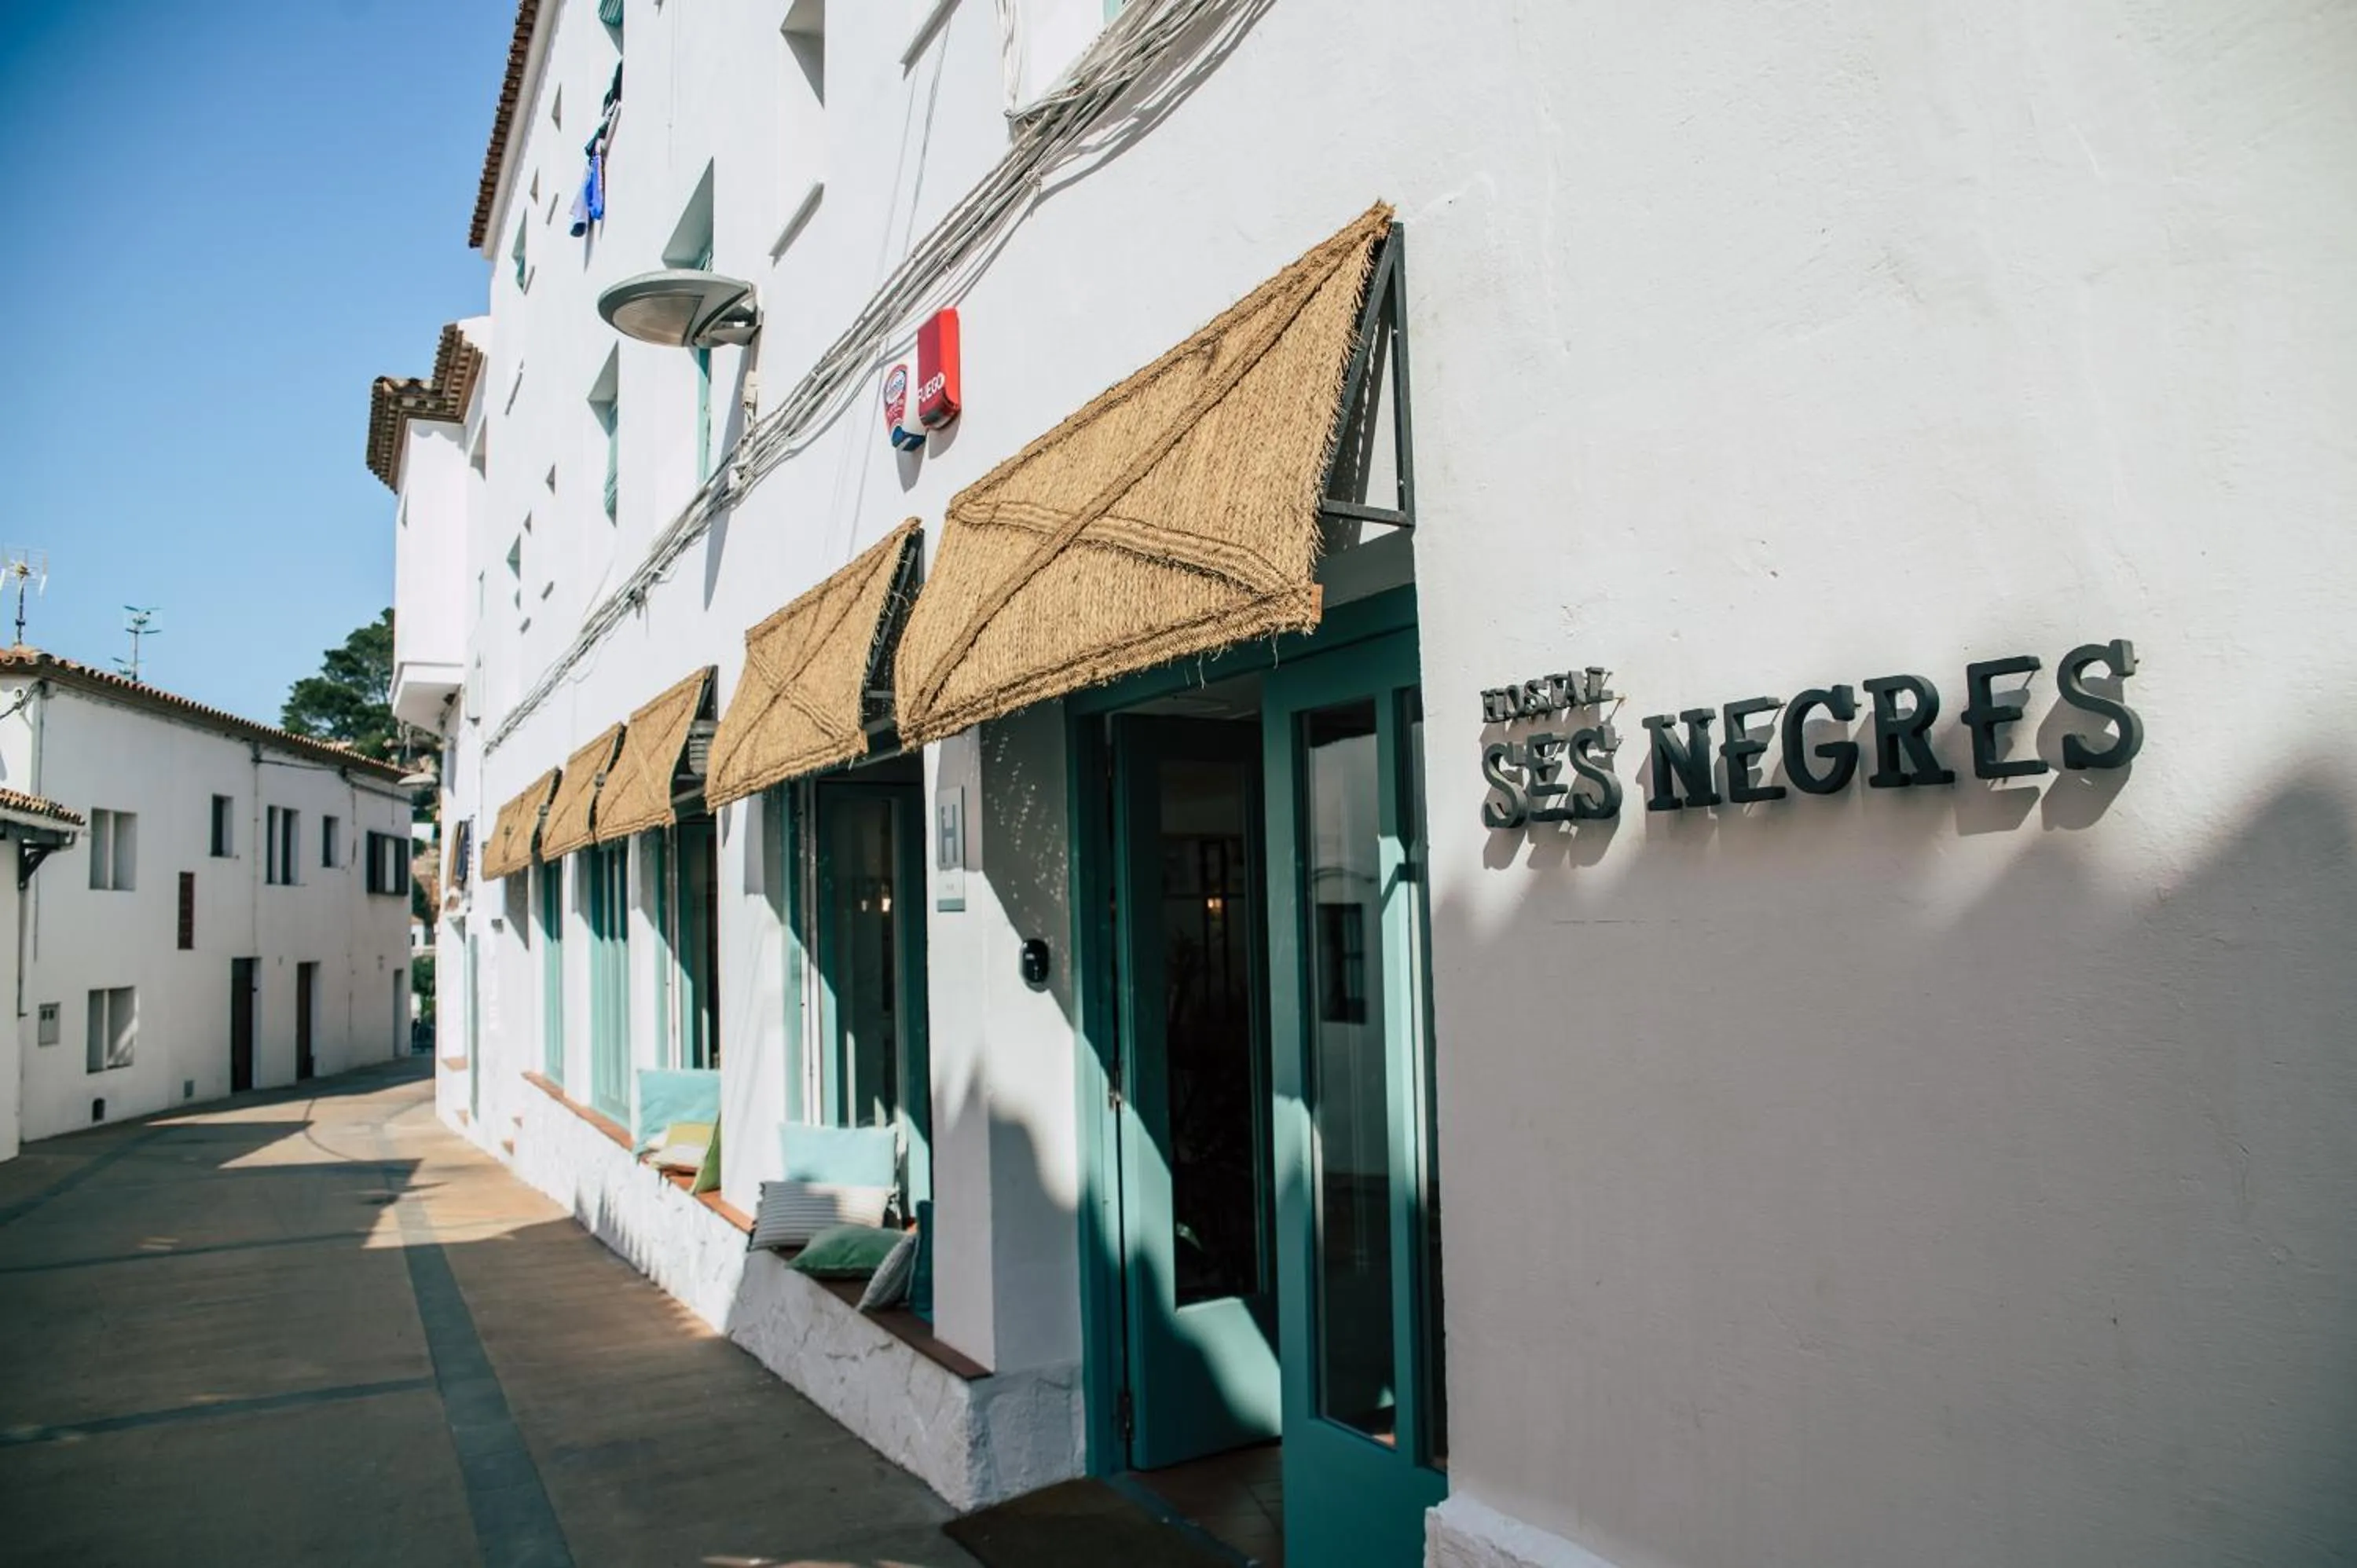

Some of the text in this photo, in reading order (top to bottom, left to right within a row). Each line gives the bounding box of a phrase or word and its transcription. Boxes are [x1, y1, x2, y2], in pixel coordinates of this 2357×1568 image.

[1480, 666, 1614, 724] HOSTAL
[1482, 638, 2145, 830] SES NEGRES
[941, 803, 958, 863] H
